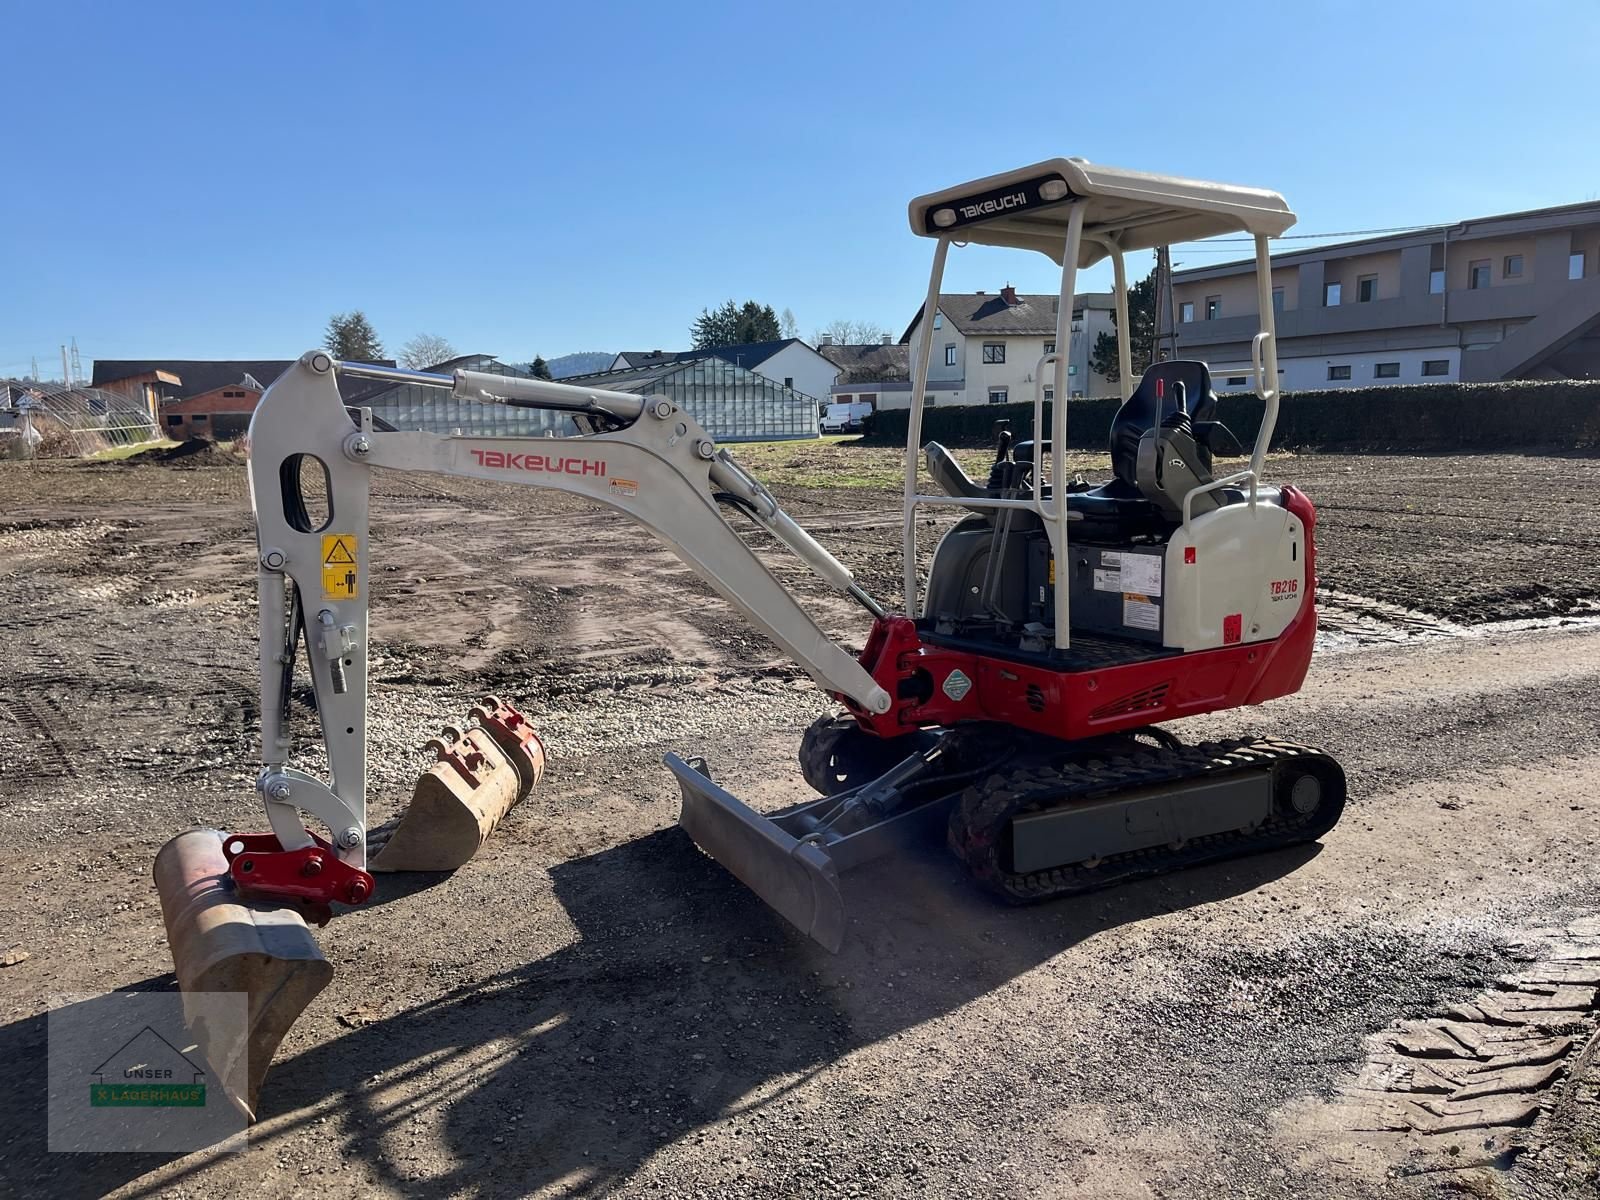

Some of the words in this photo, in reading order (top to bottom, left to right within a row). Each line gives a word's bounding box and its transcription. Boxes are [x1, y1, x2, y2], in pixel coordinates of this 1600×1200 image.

[960, 192, 1027, 218] TAKEUCHI
[470, 450, 606, 476] TAKEUCHI
[1271, 579, 1298, 595] TB216
